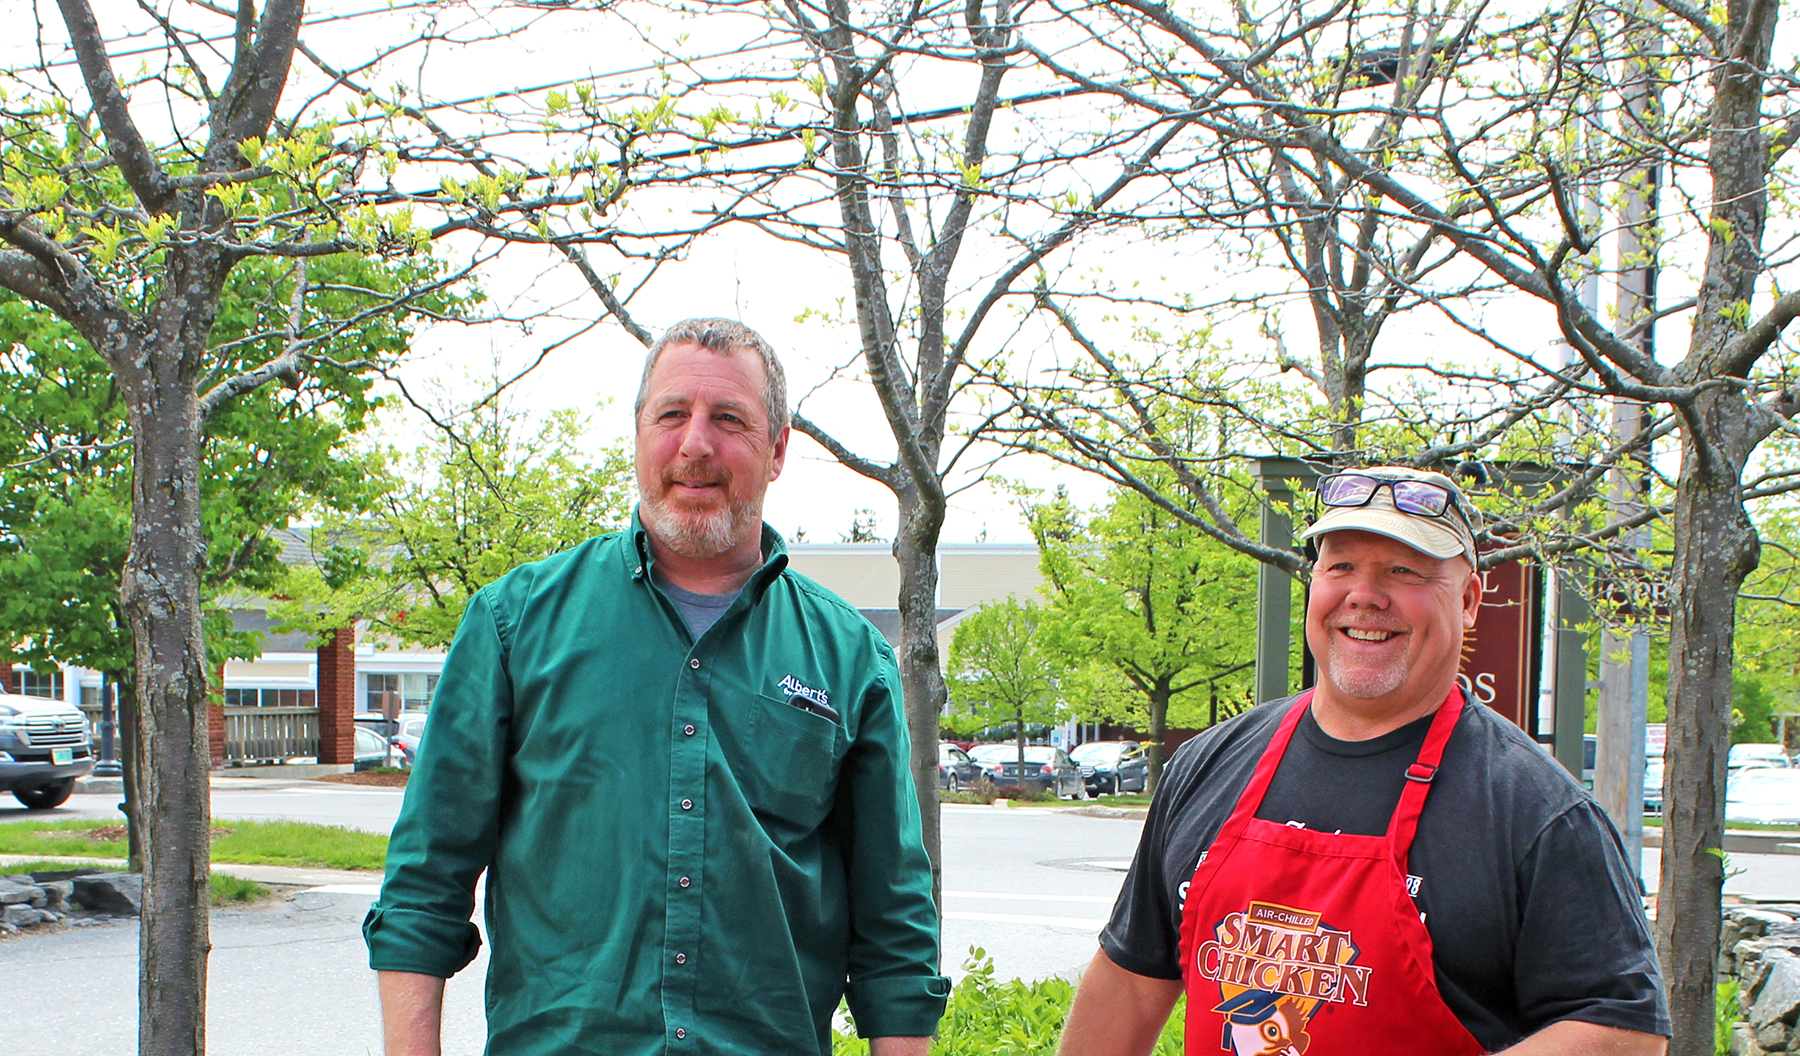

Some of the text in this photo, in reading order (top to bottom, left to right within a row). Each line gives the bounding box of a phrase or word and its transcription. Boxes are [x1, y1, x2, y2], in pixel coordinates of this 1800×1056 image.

[777, 674, 828, 704] Albert's
[1255, 908, 1316, 927] AIR-CHILLED
[1220, 912, 1352, 966] SMART
[1197, 940, 1373, 1007] CHICKEN
